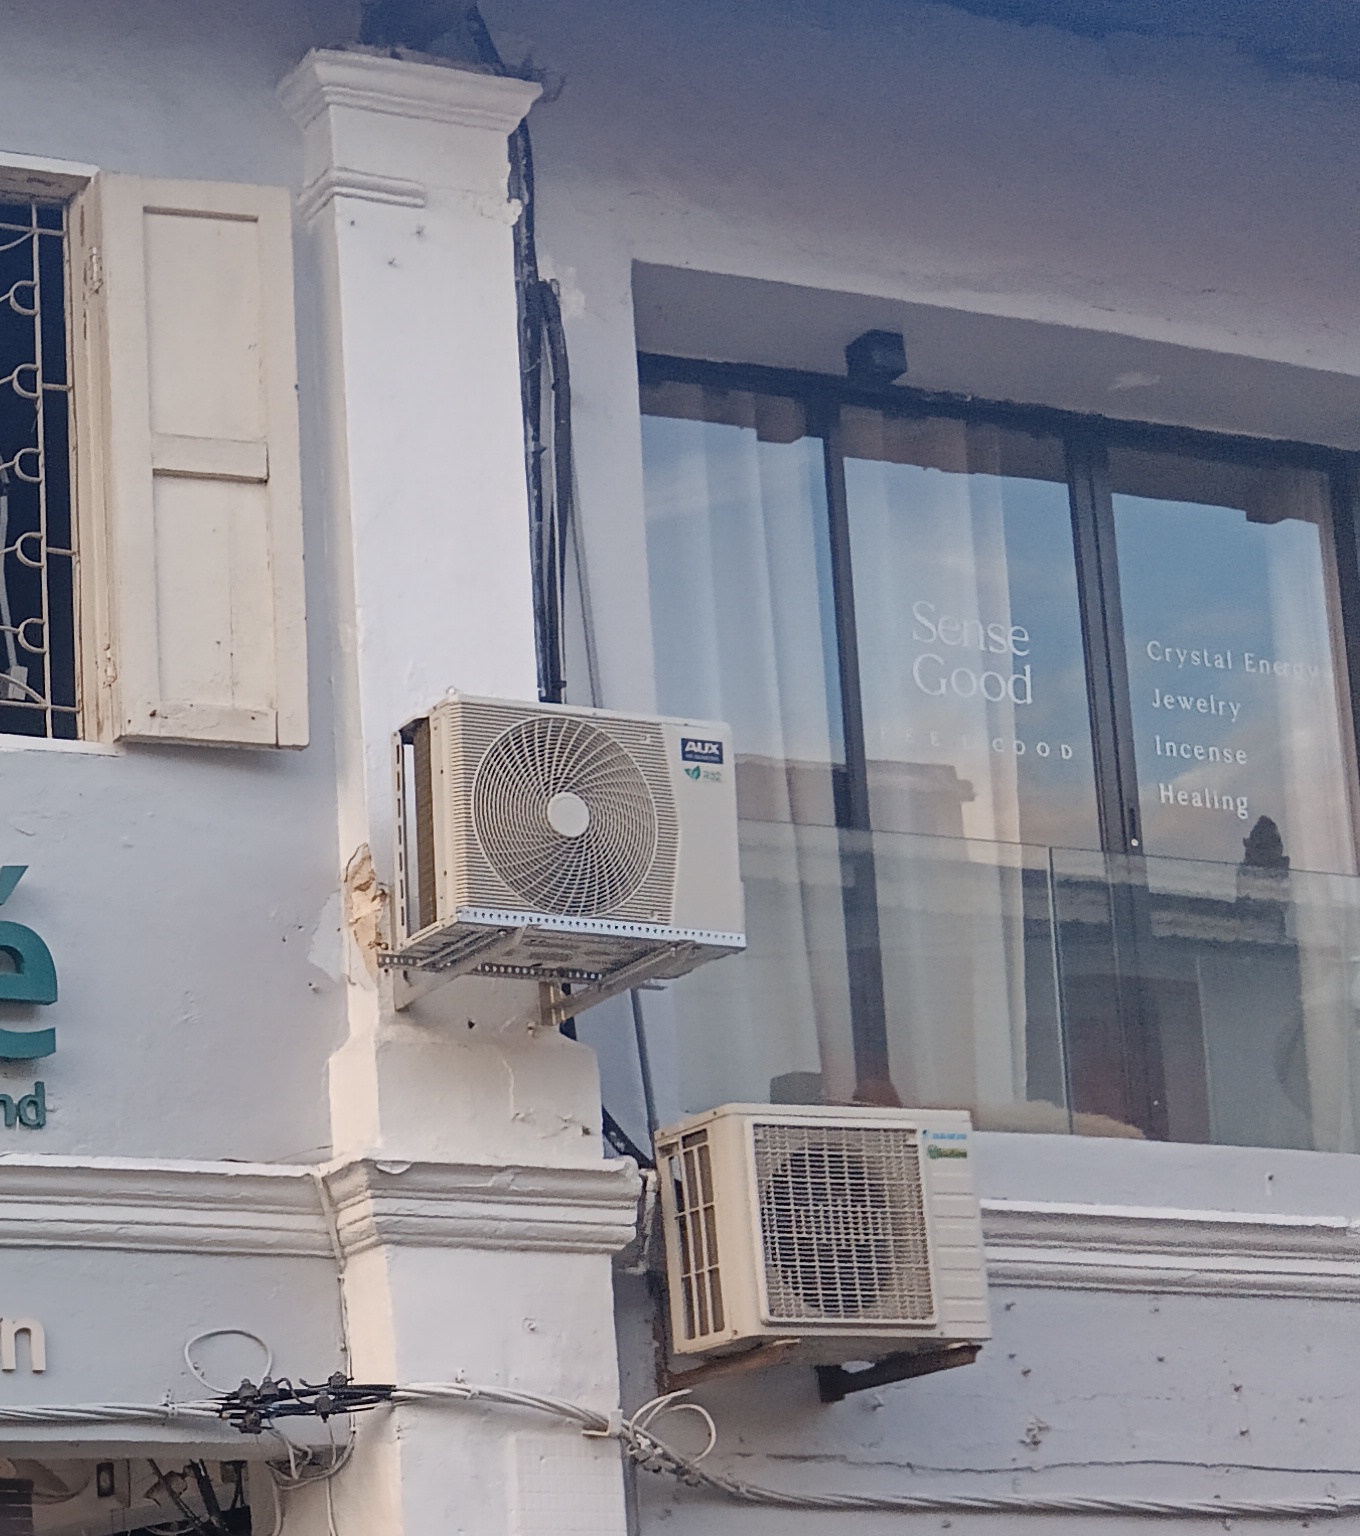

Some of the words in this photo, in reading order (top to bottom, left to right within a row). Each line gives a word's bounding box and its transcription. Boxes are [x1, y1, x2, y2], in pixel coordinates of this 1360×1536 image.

[912, 600, 1030, 656] Sense
[912, 653, 1033, 704] Good
[1146, 640, 1232, 670] Crystal
[1244, 652, 1319, 685] Energy
[1152, 688, 1241, 722] Jewelry
[684, 741, 720, 755] AUX
[1155, 735, 1248, 765] Incense
[1158, 782, 1249, 819] Healing
